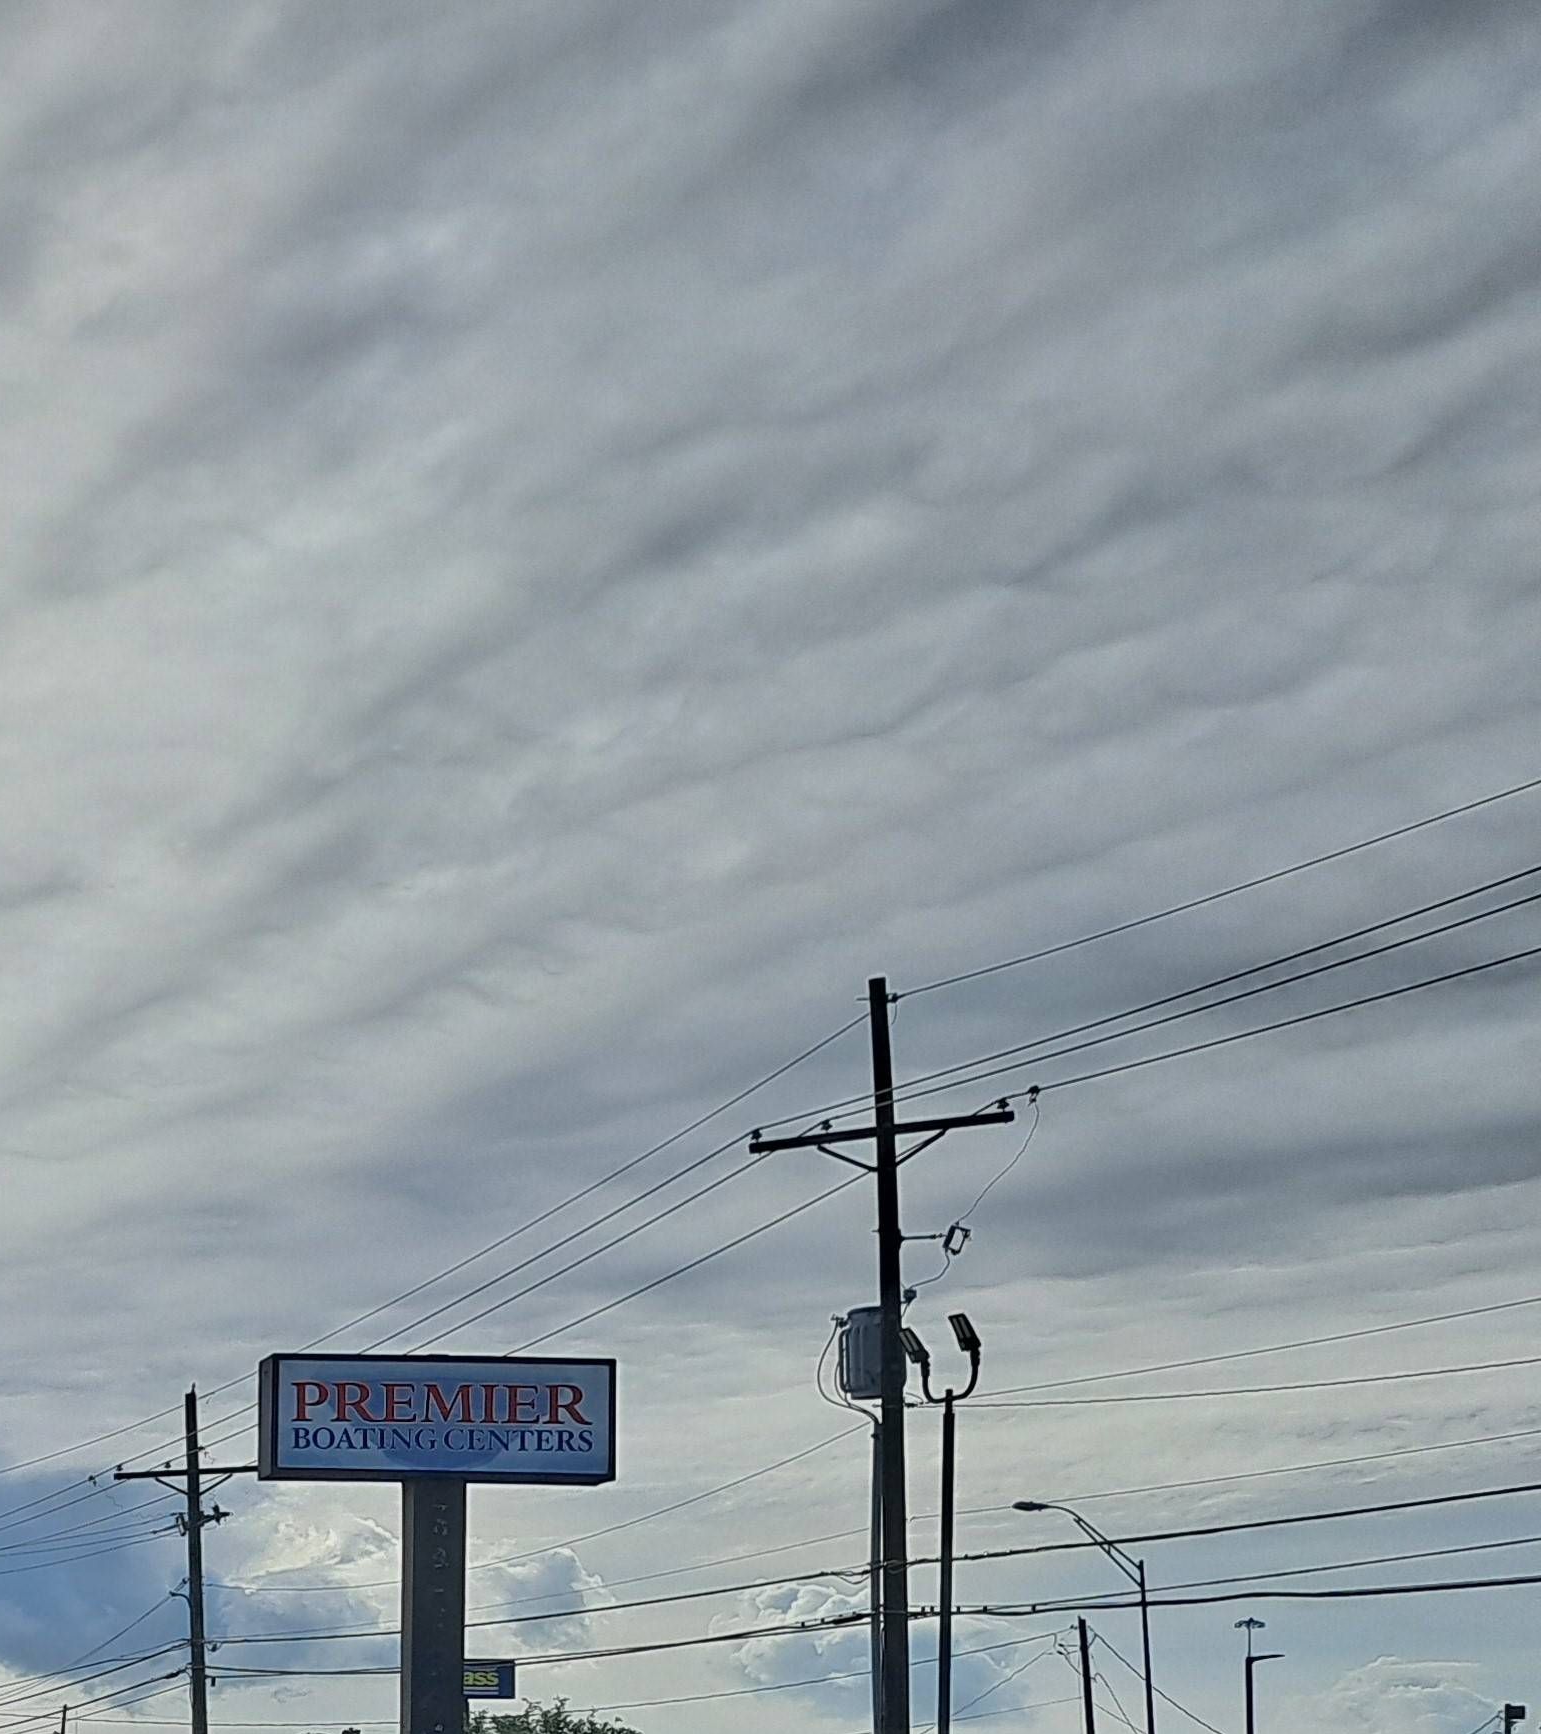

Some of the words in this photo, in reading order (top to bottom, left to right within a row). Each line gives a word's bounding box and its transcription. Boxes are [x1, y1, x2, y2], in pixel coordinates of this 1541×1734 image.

[291, 1381, 594, 1426] PREMIER
[291, 1427, 436, 1451] BOATING
[443, 1428, 595, 1453] CENTERS
